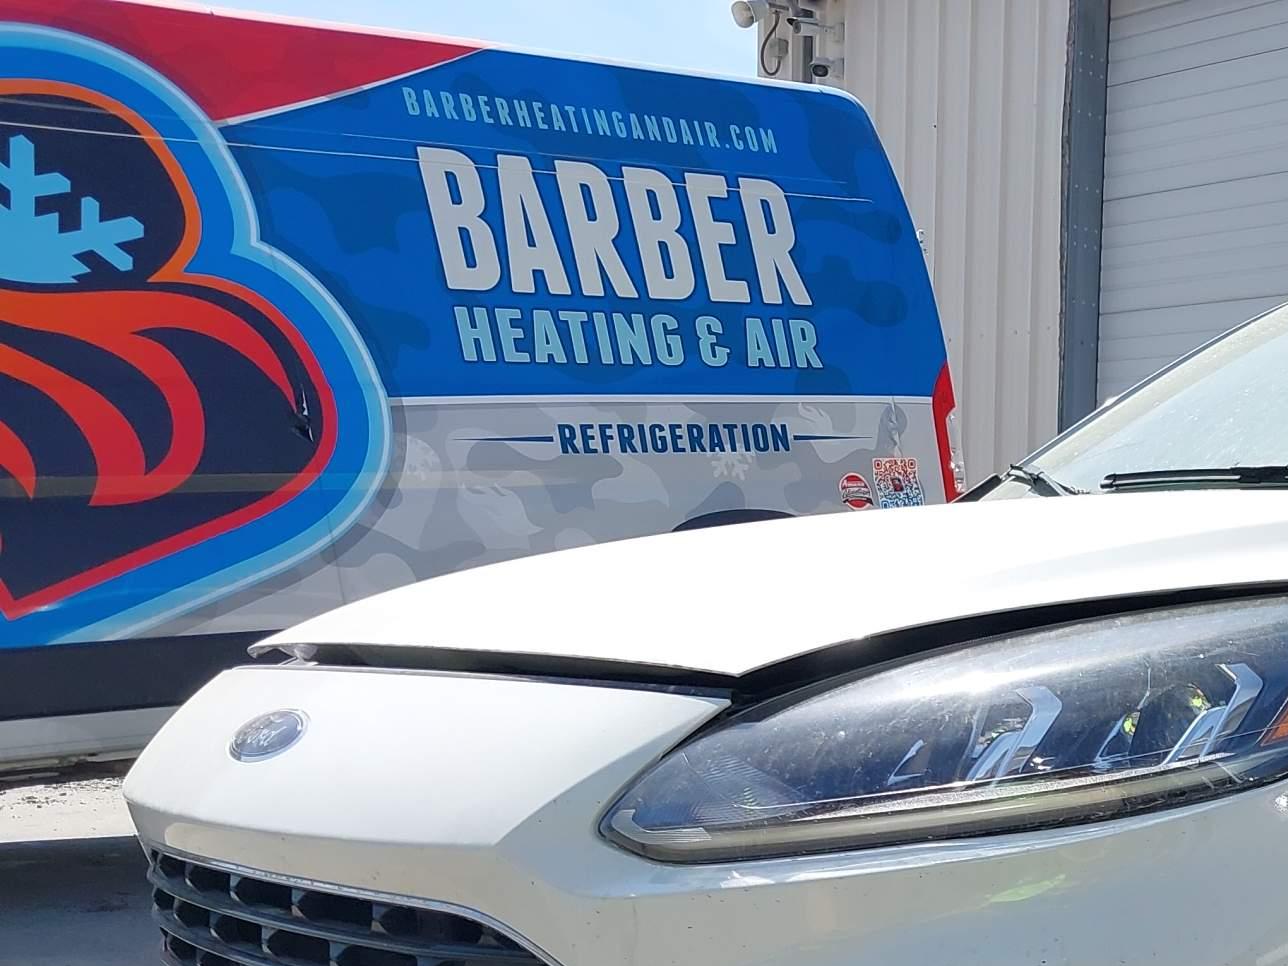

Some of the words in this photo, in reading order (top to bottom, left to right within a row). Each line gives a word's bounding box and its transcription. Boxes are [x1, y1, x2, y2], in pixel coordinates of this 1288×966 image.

[402, 86, 778, 155] BARBERHEATINGANDAIR.COM
[416, 146, 813, 306] BARBER
[453, 307, 684, 366] HEATING
[698, 315, 731, 366] &
[747, 318, 824, 370] AIR
[559, 423, 791, 455] REFRIGERATION
